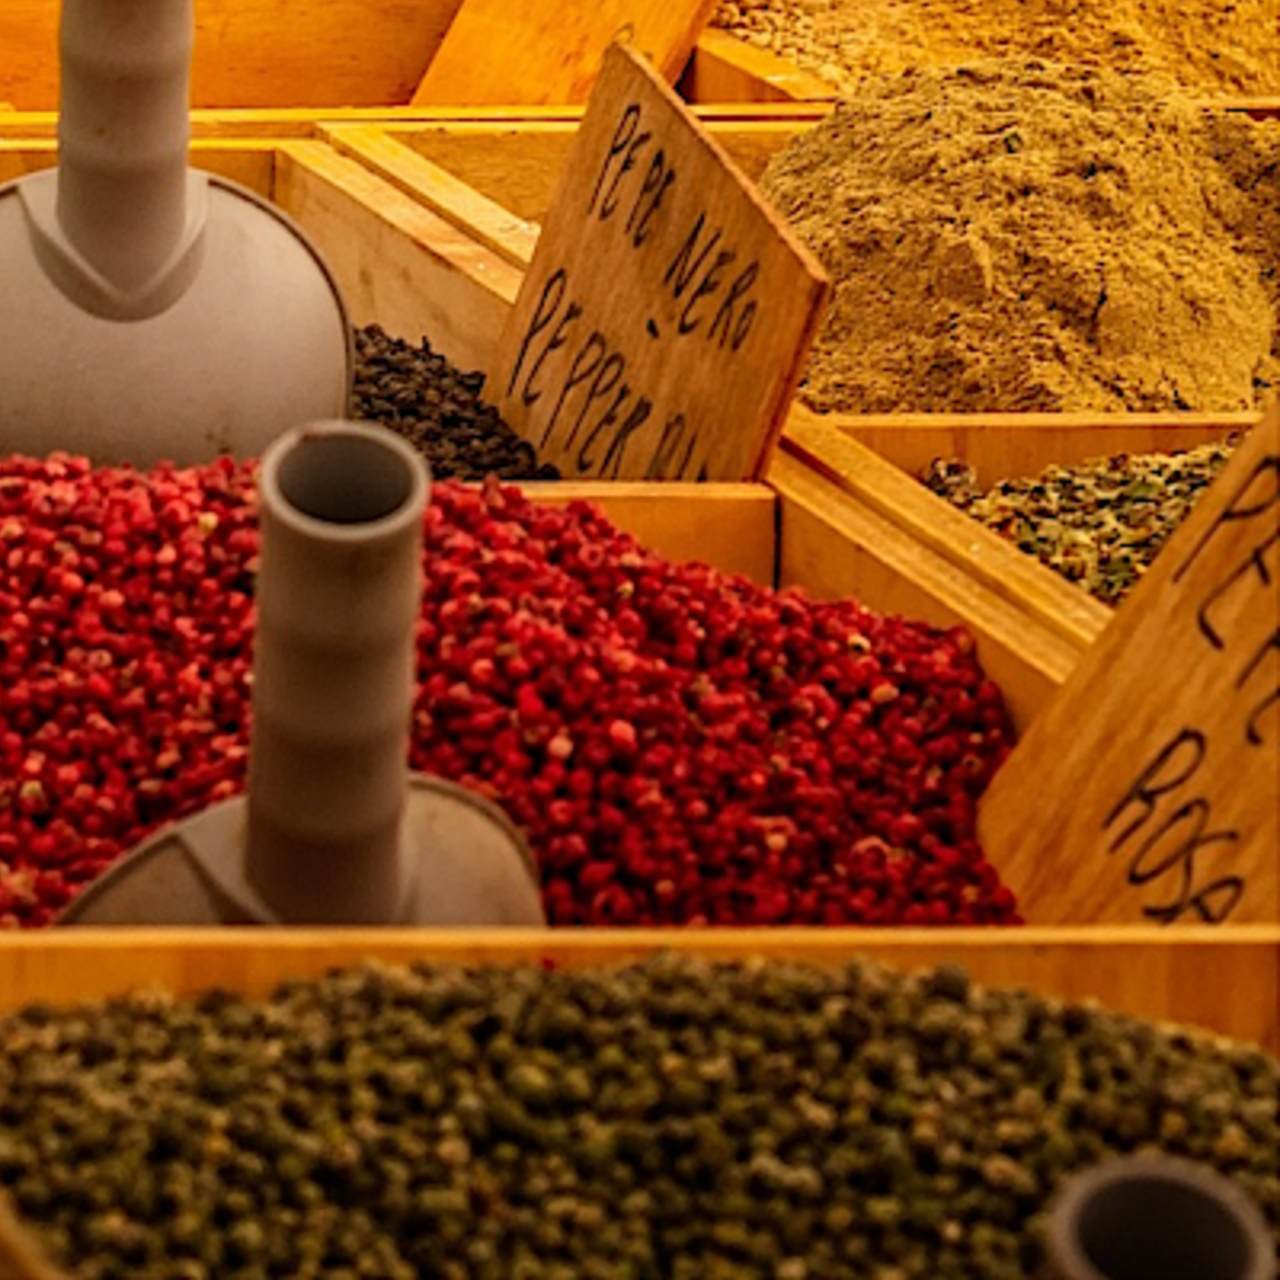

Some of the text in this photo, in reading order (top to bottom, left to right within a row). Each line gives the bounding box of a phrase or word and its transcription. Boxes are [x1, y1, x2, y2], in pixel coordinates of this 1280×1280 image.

[588, 102, 677, 249] PEPE
[663, 211, 761, 352] NERO
[506, 266, 653, 481] PEPPER
